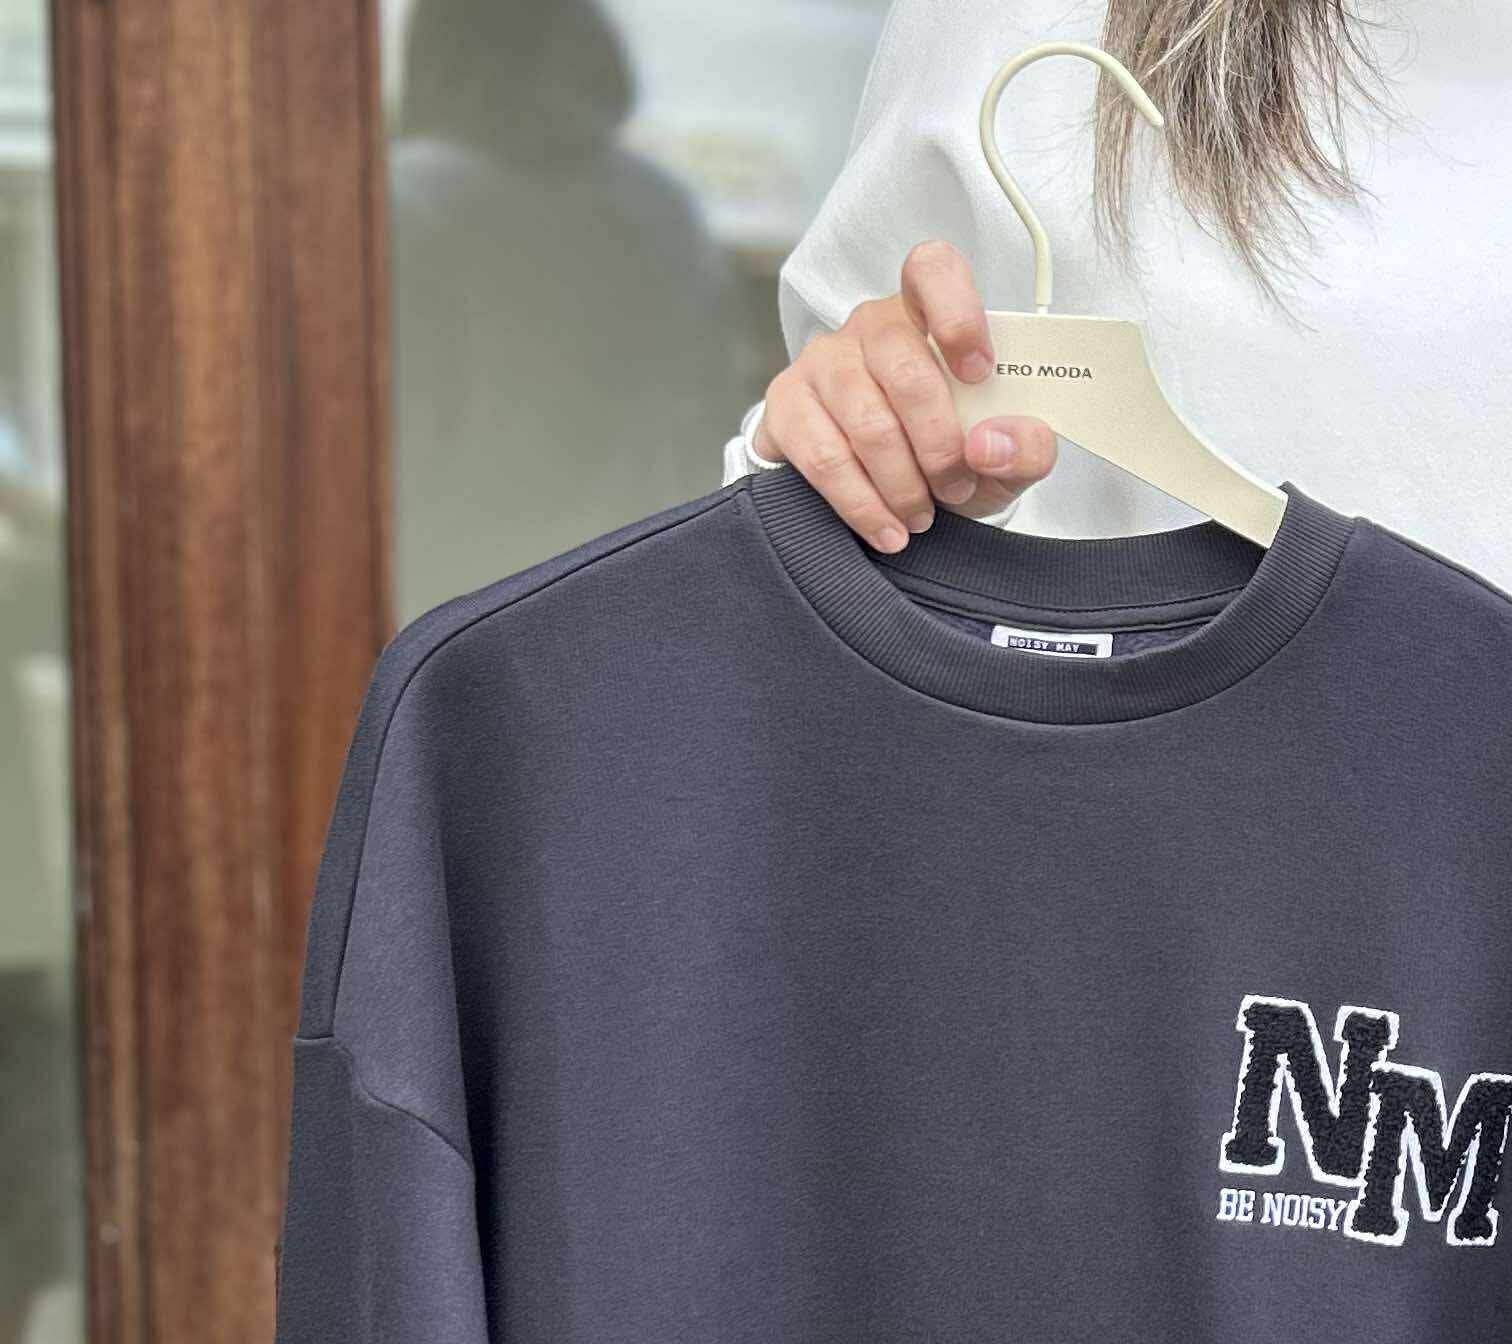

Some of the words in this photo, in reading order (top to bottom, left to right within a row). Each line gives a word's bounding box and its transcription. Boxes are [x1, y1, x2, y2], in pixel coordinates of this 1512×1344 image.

[996, 363, 1033, 377] ERO
[1037, 365, 1093, 379] MODA
[1009, 637, 1049, 649] NOISY
[1056, 643, 1079, 653] MAY
[1216, 1188, 1255, 1222] BE
[1260, 1193, 1347, 1231] NOISY
